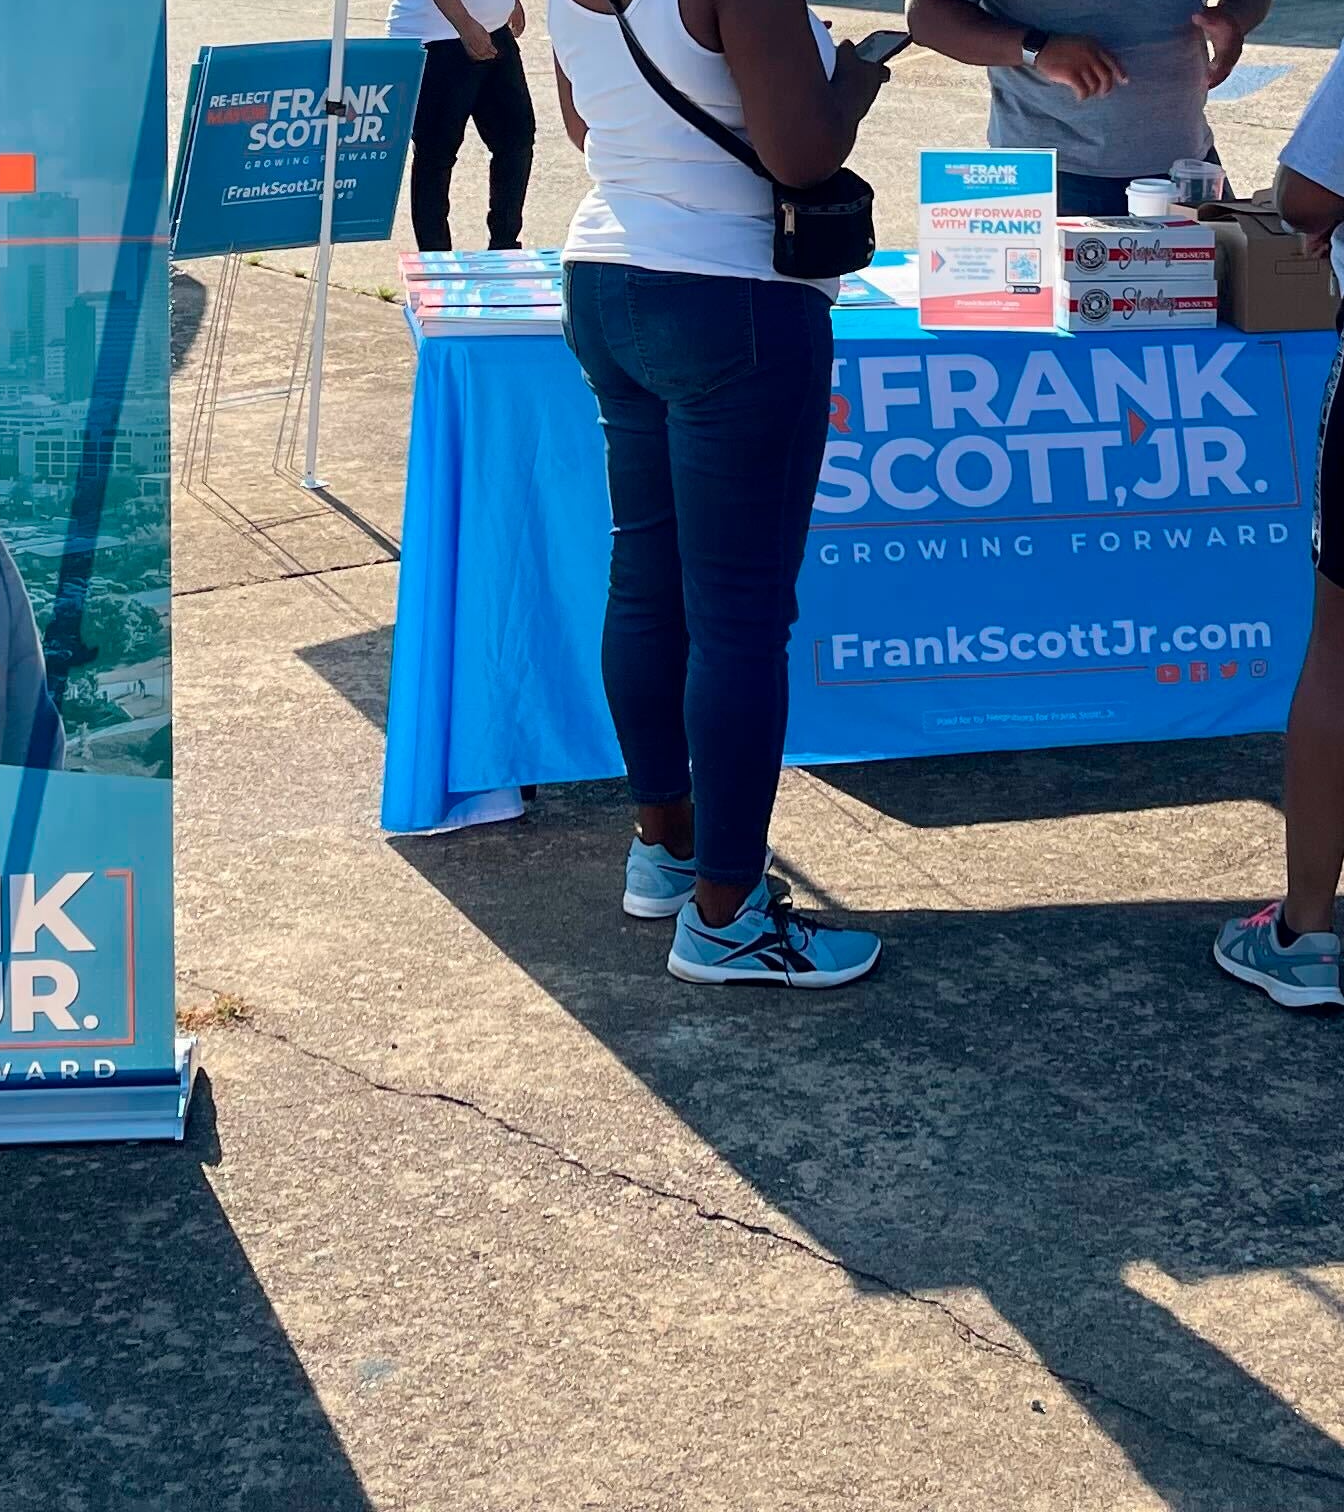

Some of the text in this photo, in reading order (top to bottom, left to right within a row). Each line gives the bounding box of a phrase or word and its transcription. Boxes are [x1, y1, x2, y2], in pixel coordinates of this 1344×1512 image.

[209, 90, 271, 108] RE-ELECT
[320, 150, 388, 164] FRWARD
[969, 164, 1019, 176] FRANK
[931, 207, 1042, 219] GROW FORWARD
[931, 219, 1042, 235] WITH FRANK!
[859, 341, 1257, 433] FRANK
[820, 522, 1290, 565] GROWING FORWARD
[830, 618, 1272, 670] FrankScottJr.com
